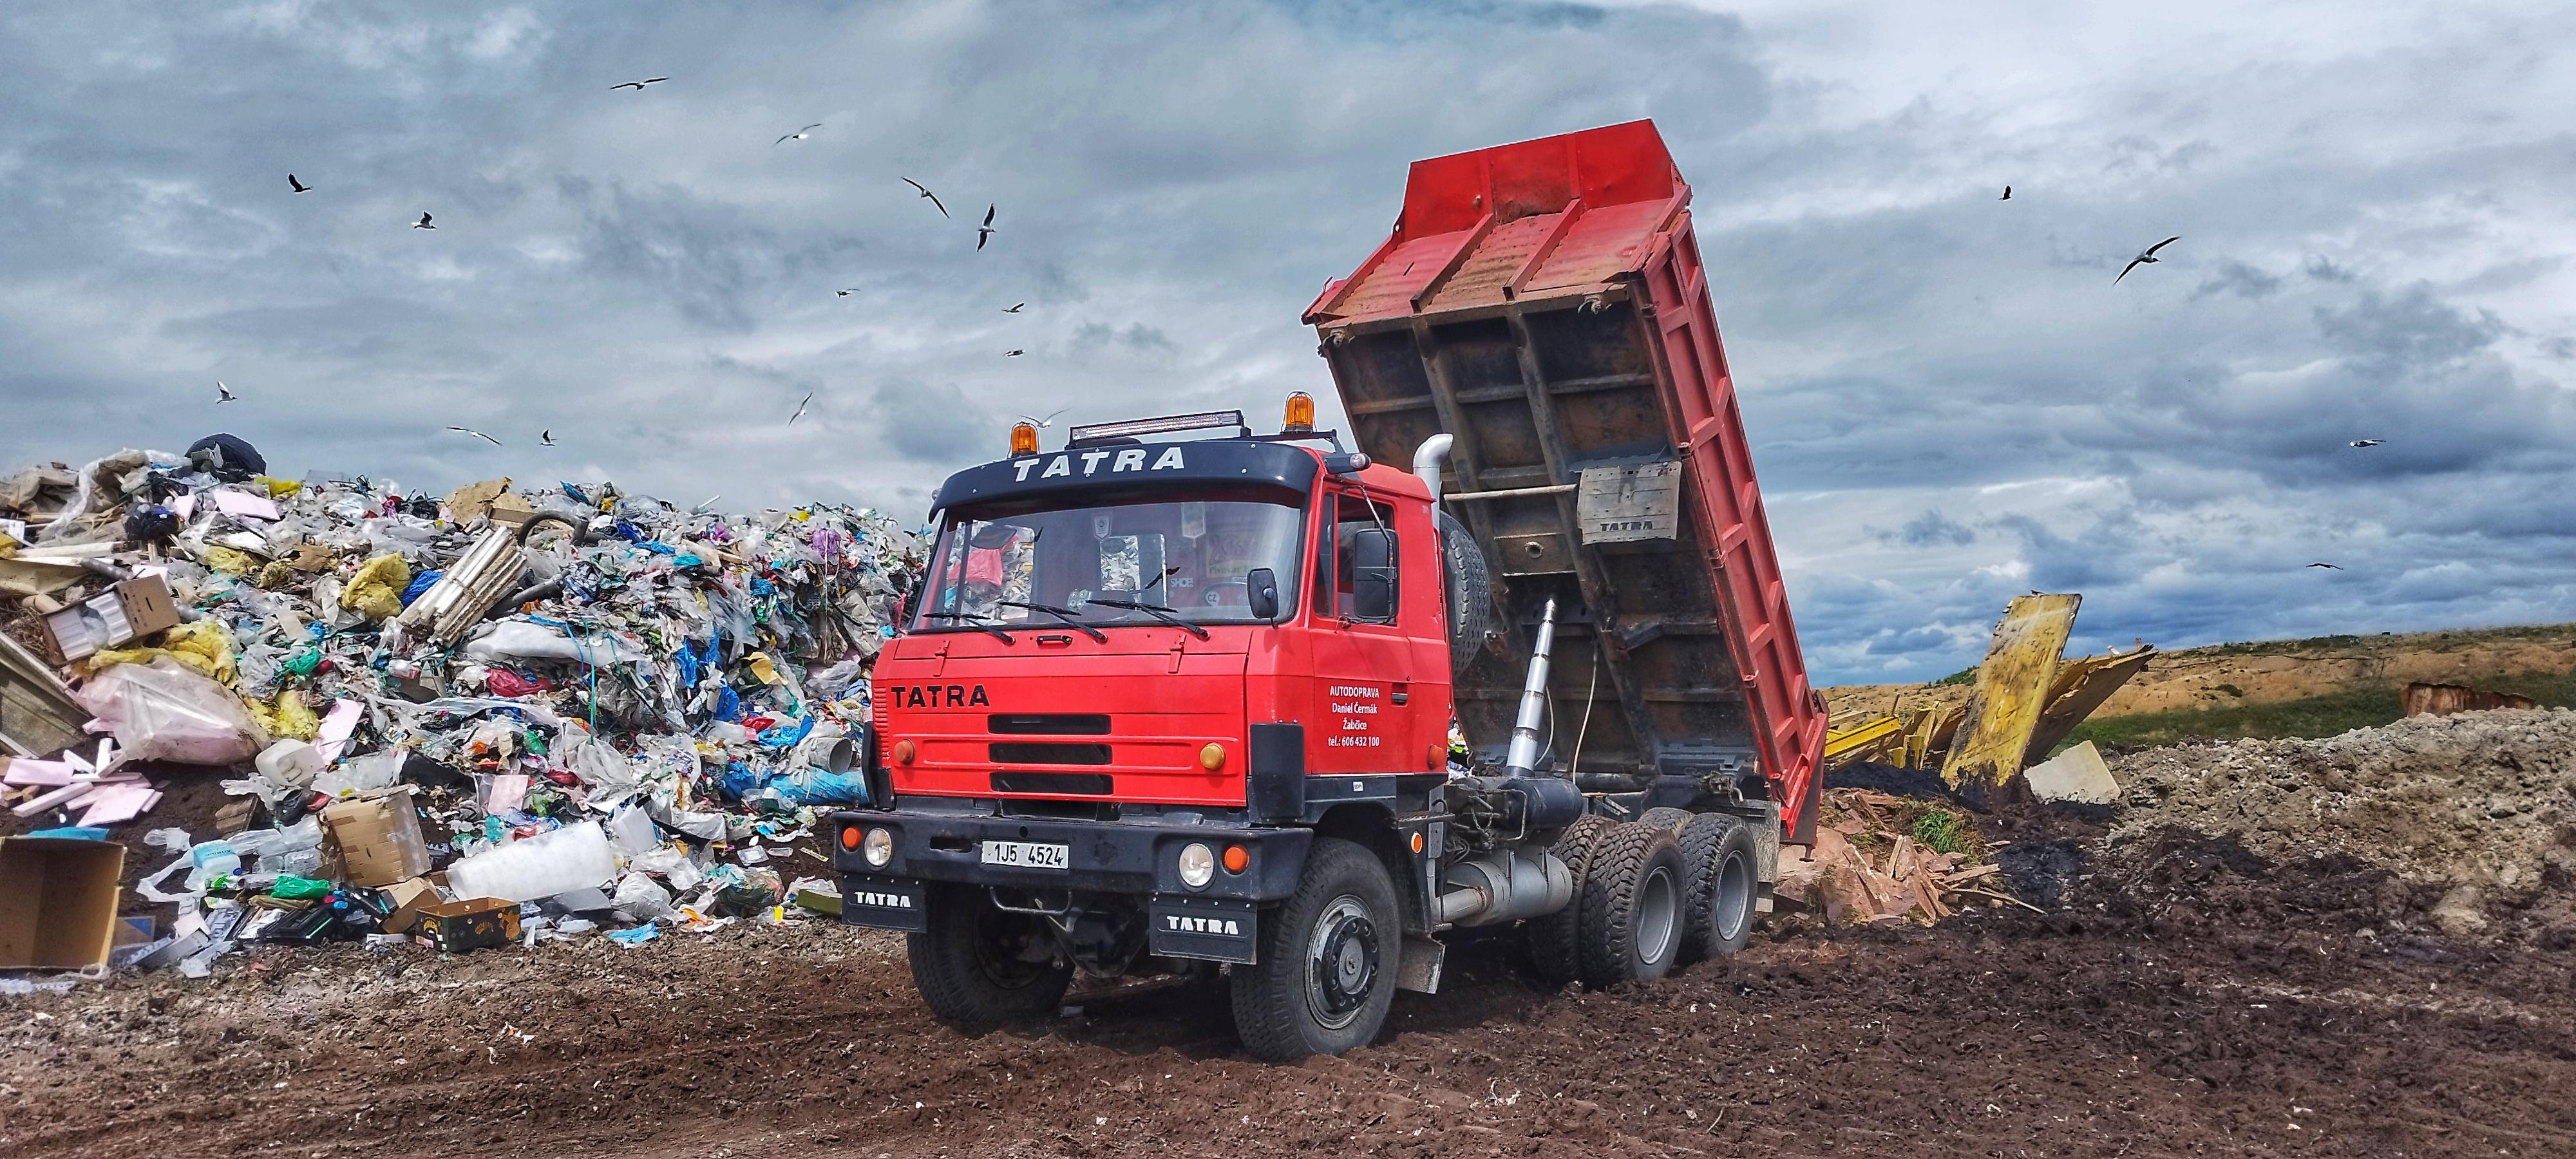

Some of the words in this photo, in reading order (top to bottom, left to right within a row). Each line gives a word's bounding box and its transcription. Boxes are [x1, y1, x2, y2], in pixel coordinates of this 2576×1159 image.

[1012, 447, 1185, 482] TATRA
[1600, 521, 1654, 532] TATRA
[891, 684, 990, 708] TATRA
[1329, 685, 1379, 698] AUTODOPRAVA
[1332, 701, 1353, 713] Daniel
[1354, 701, 1378, 714] Čermák
[1341, 736, 1354, 747] 606
[1354, 736, 1367, 747] 432
[1368, 735, 1379, 747] 100
[994, 843, 1018, 862] 1J5
[1028, 845, 1064, 866] 4524
[854, 891, 911, 908] TATRA
[1166, 916, 1239, 935] TATRA
